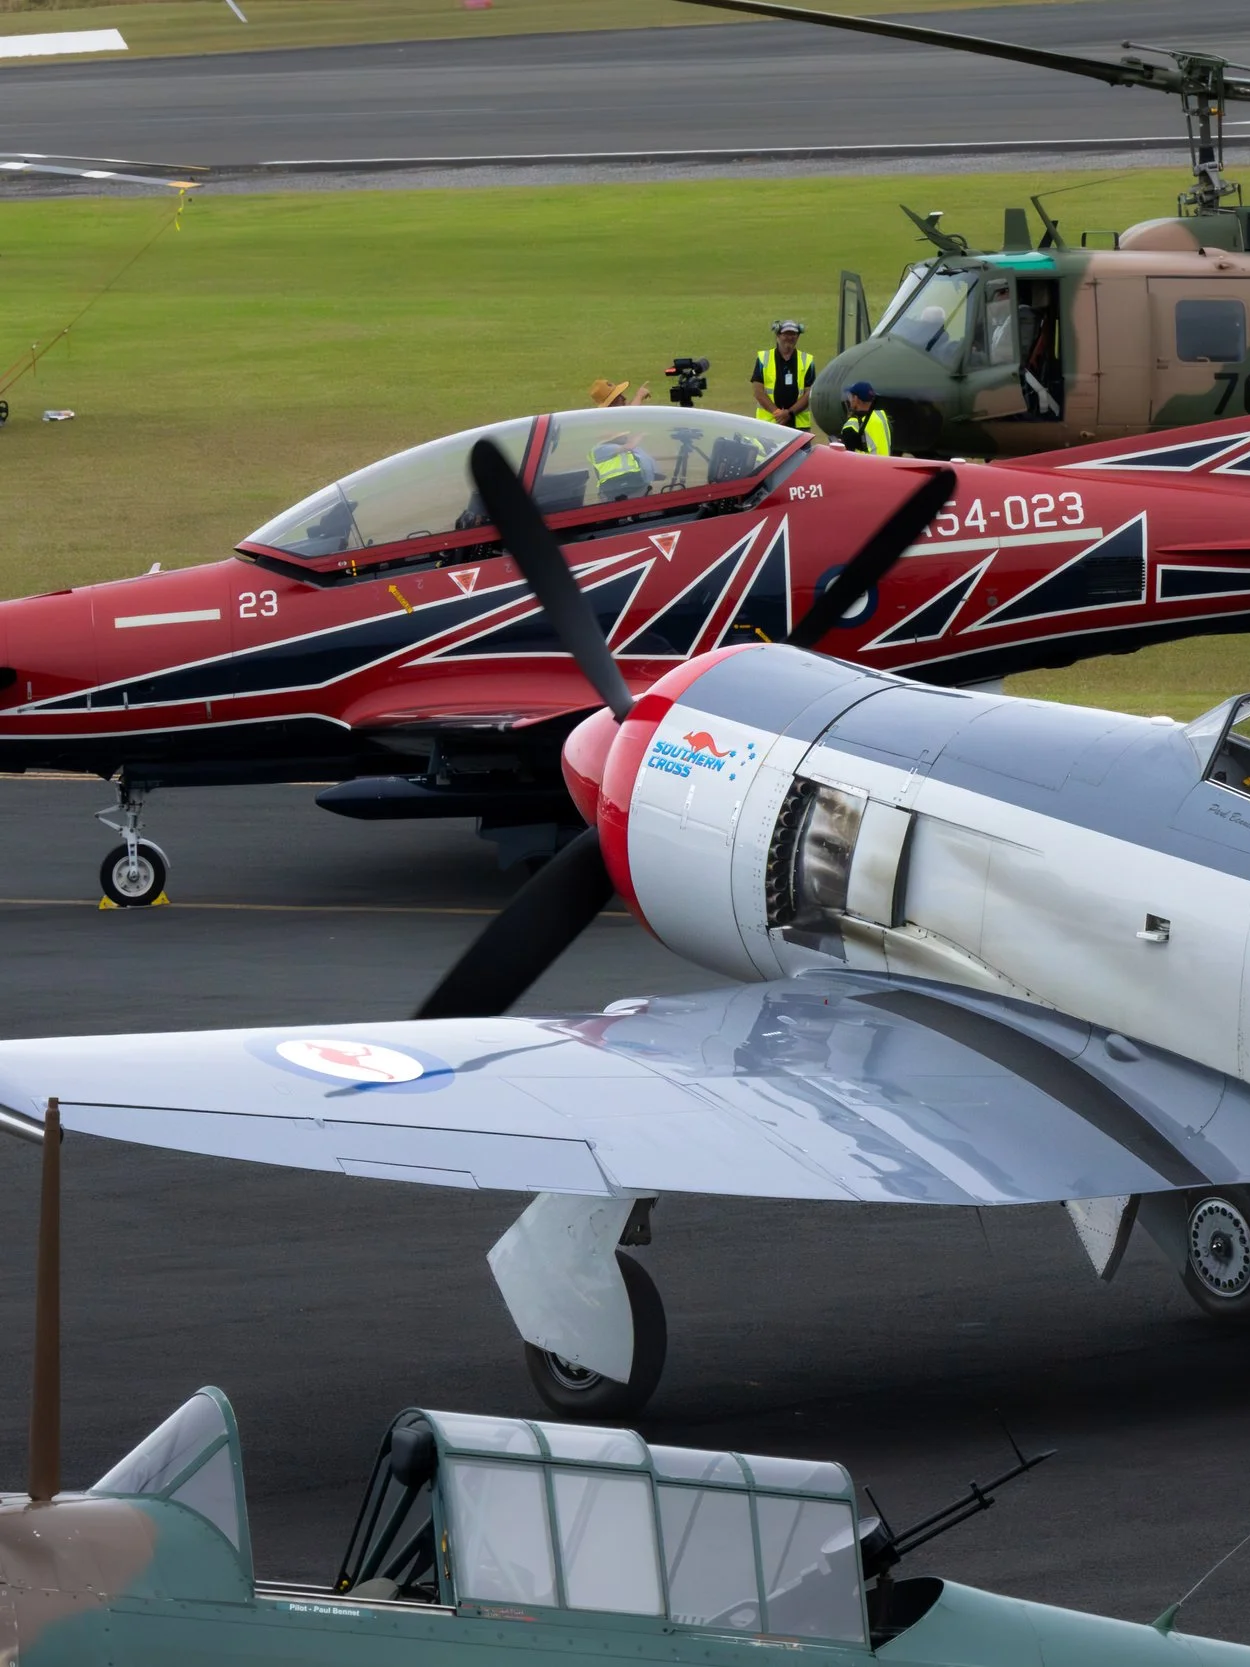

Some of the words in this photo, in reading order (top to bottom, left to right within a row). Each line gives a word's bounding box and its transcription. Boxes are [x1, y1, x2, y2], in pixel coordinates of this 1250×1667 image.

[789, 484, 824, 500] PC-21
[920, 492, 1085, 538] 54-023
[238, 590, 278, 619] 23
[647, 755, 692, 778] CROSS
[652, 740, 726, 772] SOUTHERN
[289, 1603, 307, 1612] Pilot
[313, 1605, 331, 1614] Paul
